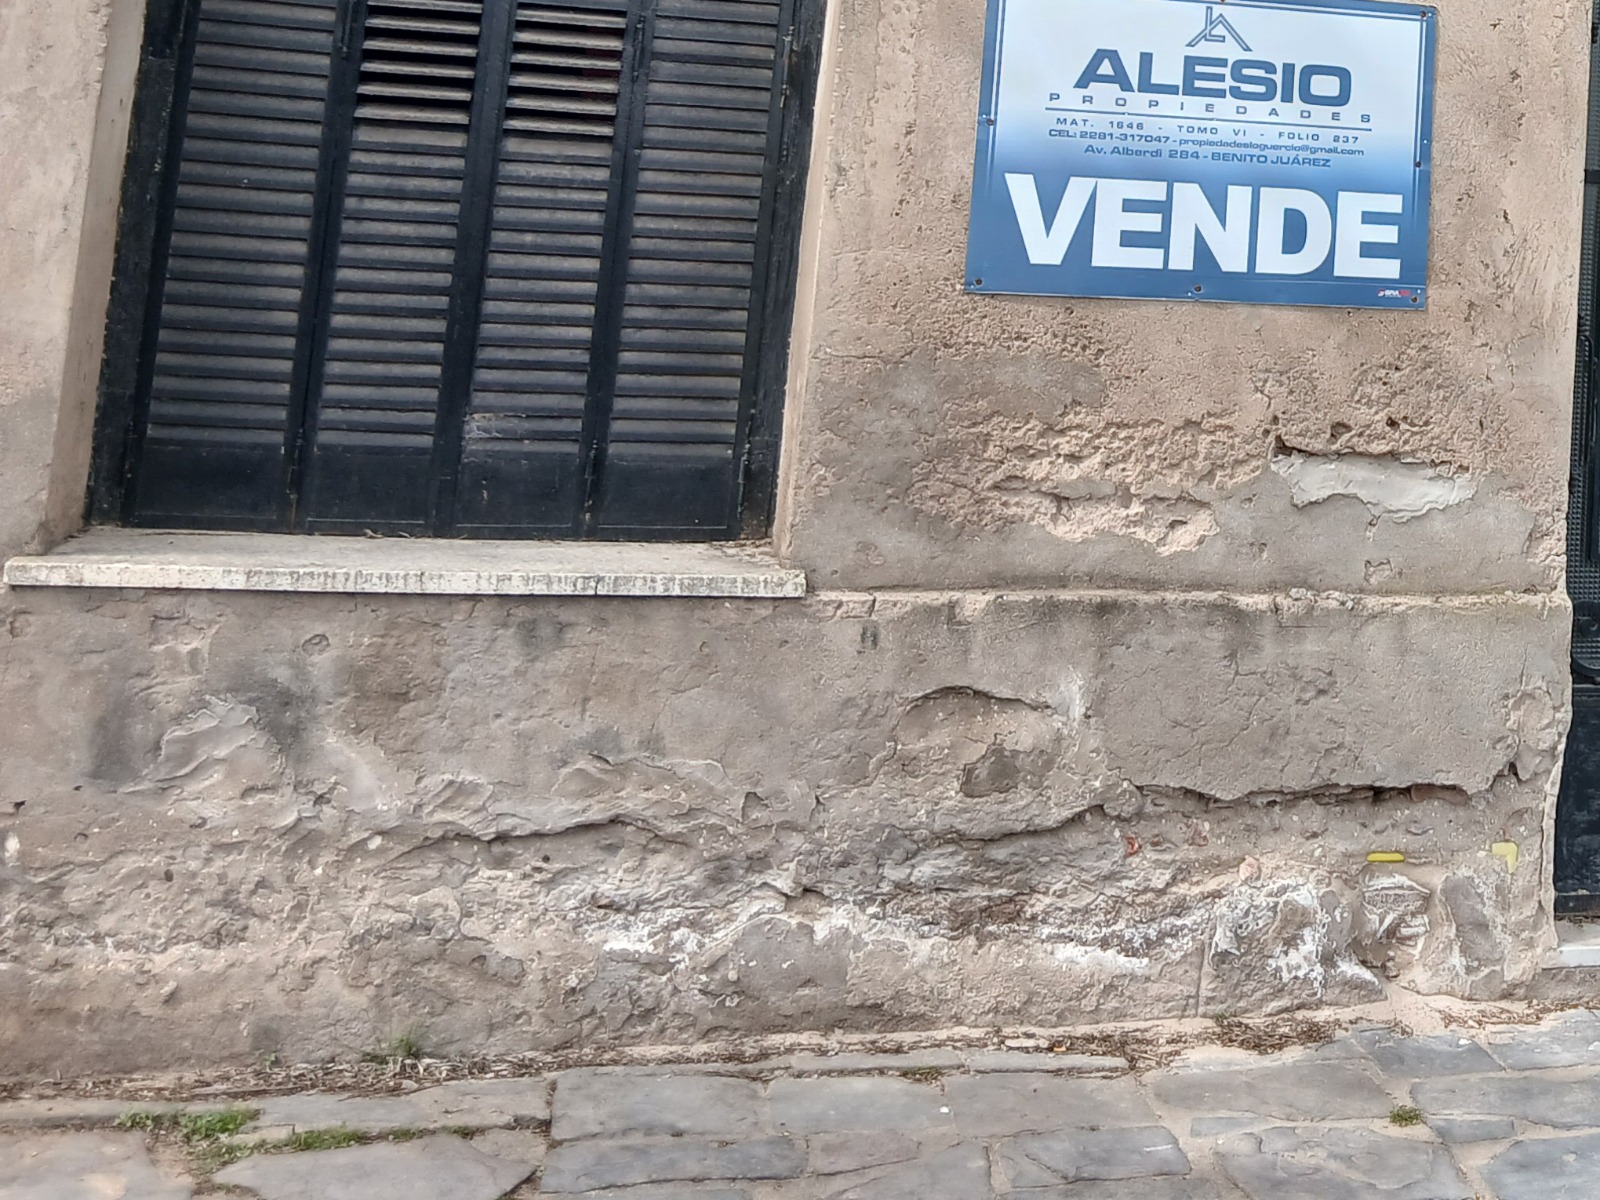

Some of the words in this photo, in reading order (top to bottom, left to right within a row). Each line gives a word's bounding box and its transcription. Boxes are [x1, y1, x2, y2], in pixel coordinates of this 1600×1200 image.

[1073, 48, 1352, 107] ALESIO
[1049, 92, 1371, 123] PROPIEDADES
[1048, 128, 1077, 139] CEL:
[1056, 117, 1095, 128] MAT.
[1176, 124, 1218, 135] TOMO
[1232, 128, 1247, 138] VI
[1278, 131, 1320, 142] FOLIO
[1083, 144, 1107, 155] Av.
[1168, 149, 1200, 160] 284
[1211, 152, 1268, 164] BENITO
[1270, 154, 1332, 168] JUÁREZ
[1004, 172, 1403, 279] VENDE
